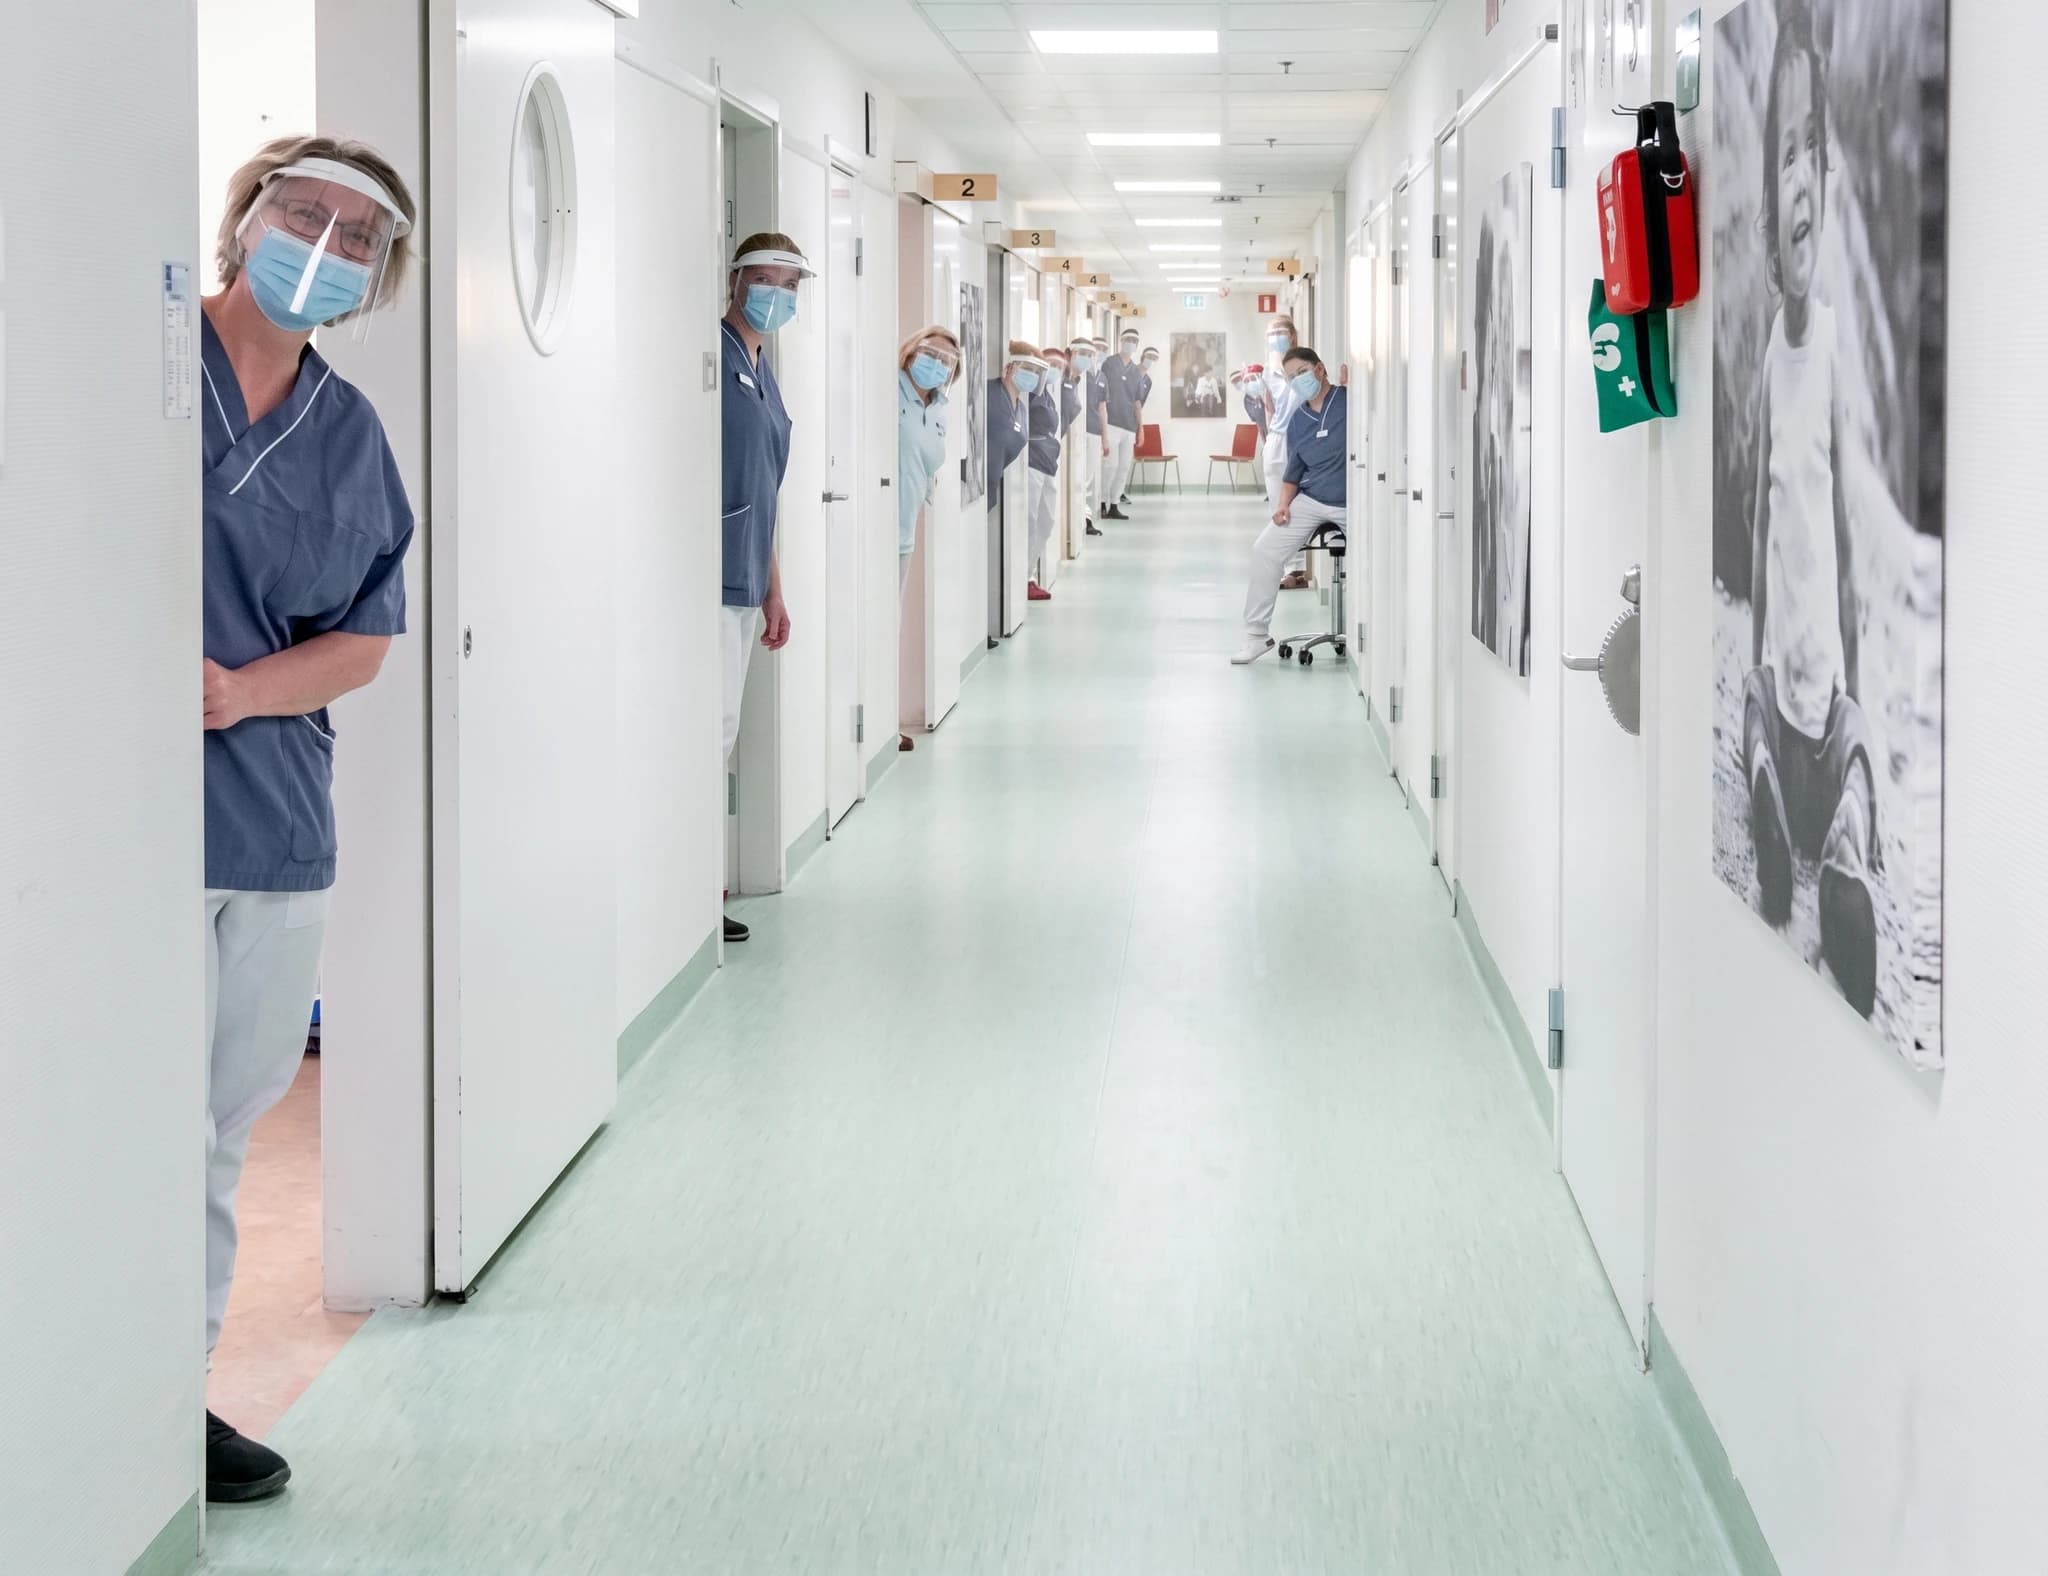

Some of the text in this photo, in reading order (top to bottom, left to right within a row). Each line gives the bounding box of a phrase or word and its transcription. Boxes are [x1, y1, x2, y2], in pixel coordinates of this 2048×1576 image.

[961, 179, 975, 197] 2
[1031, 233, 1040, 245] 3
[1062, 260, 1070, 271] 4
[1277, 262, 1285, 272] 4
[1089, 275, 1097, 285] 4
